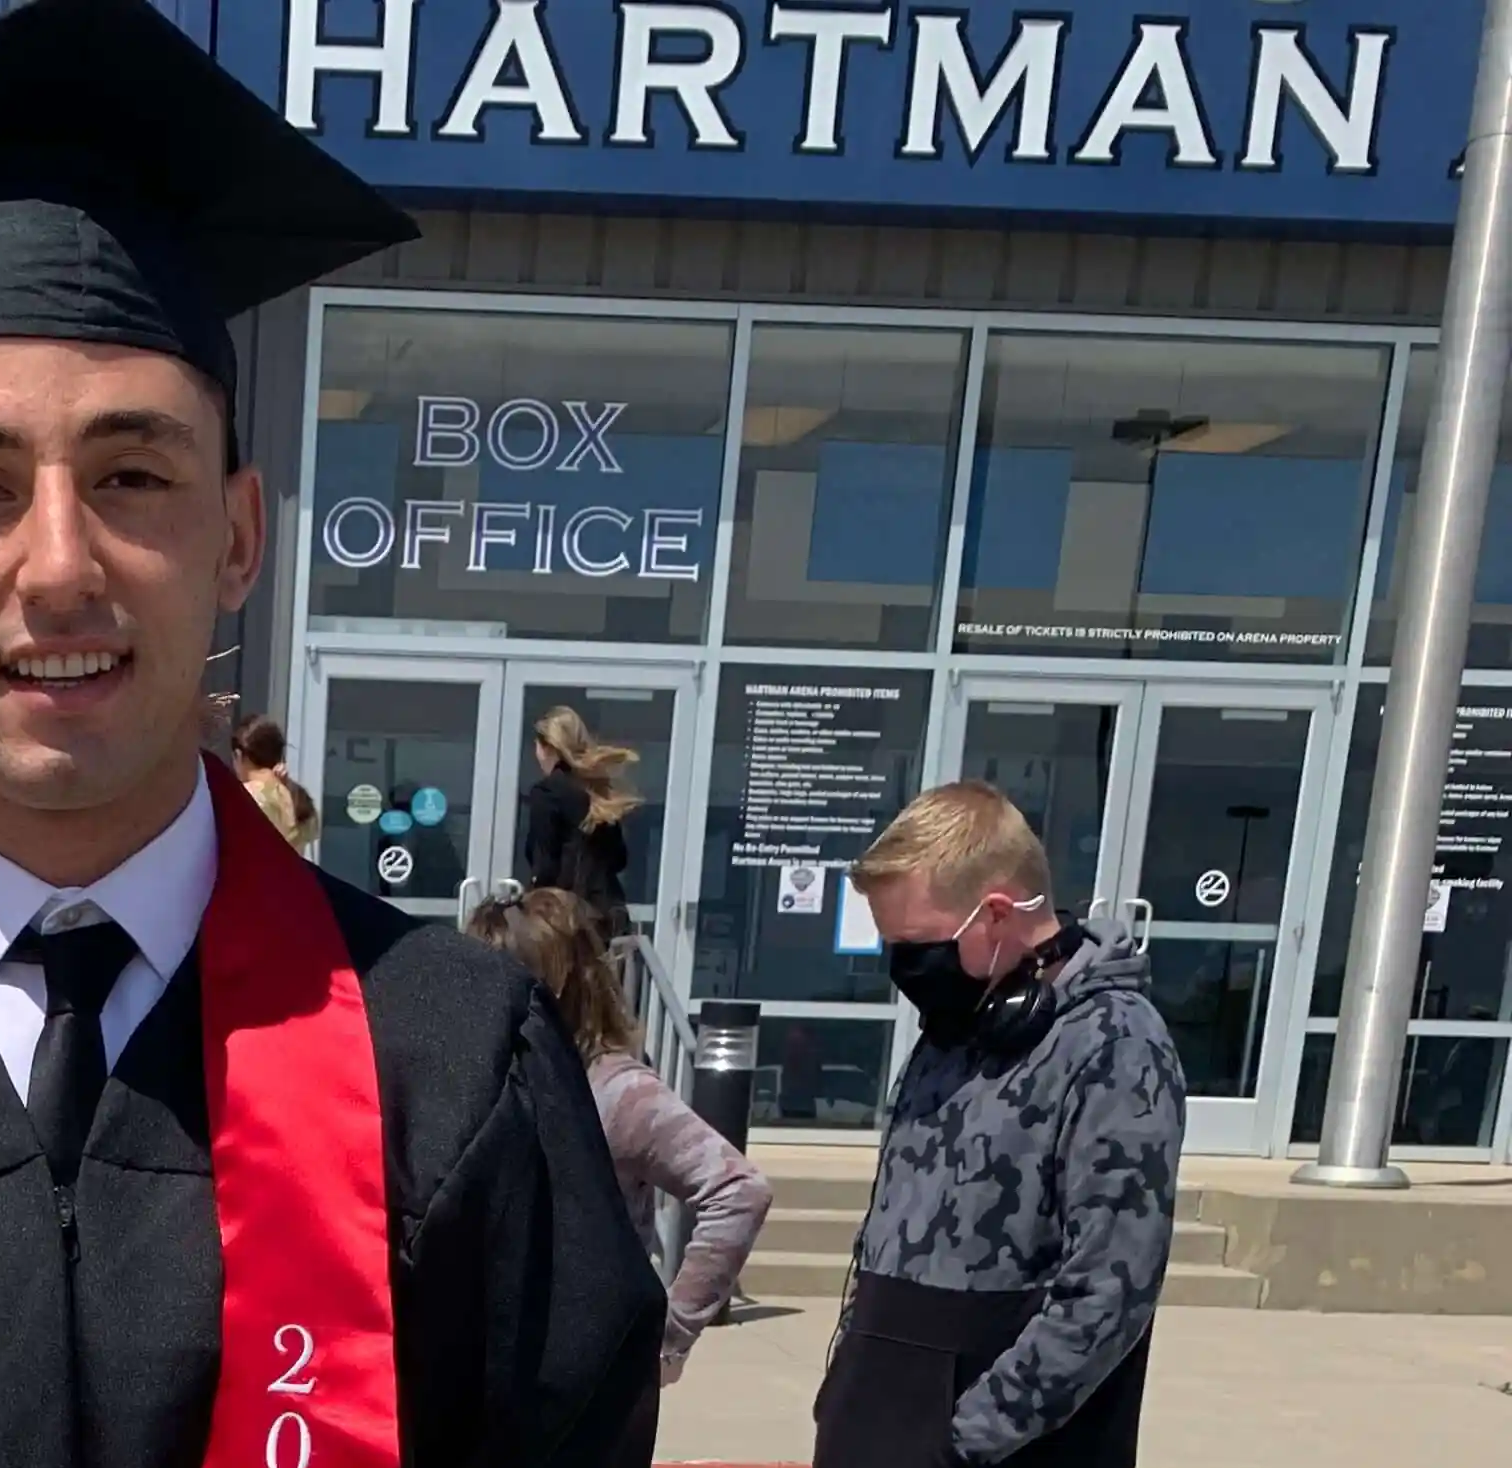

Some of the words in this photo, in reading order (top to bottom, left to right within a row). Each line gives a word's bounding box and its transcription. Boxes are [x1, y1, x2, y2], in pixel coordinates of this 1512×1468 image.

[285, 0, 1389, 173] HARTMAN
[413, 395, 628, 474] BOX
[322, 496, 703, 582] OFFICE
[958, 623, 1003, 635] RESALE
[1006, 625, 1022, 635] OF
[1025, 626, 1073, 637] TICKETS
[1075, 627, 1086, 637] IS
[1088, 627, 1144, 639] STRICTLY
[1144, 629, 1215, 642] PROHIBITED
[1216, 631, 1235, 643] ON
[1236, 632, 1278, 644] ARENA
[1280, 633, 1342, 645] PROPERTY
[745, 684, 788, 695] HARTMAN
[789, 685, 819, 697] ARENA
[820, 686, 873, 699] PROHIBITED
[873, 688, 901, 700] ITEMS
